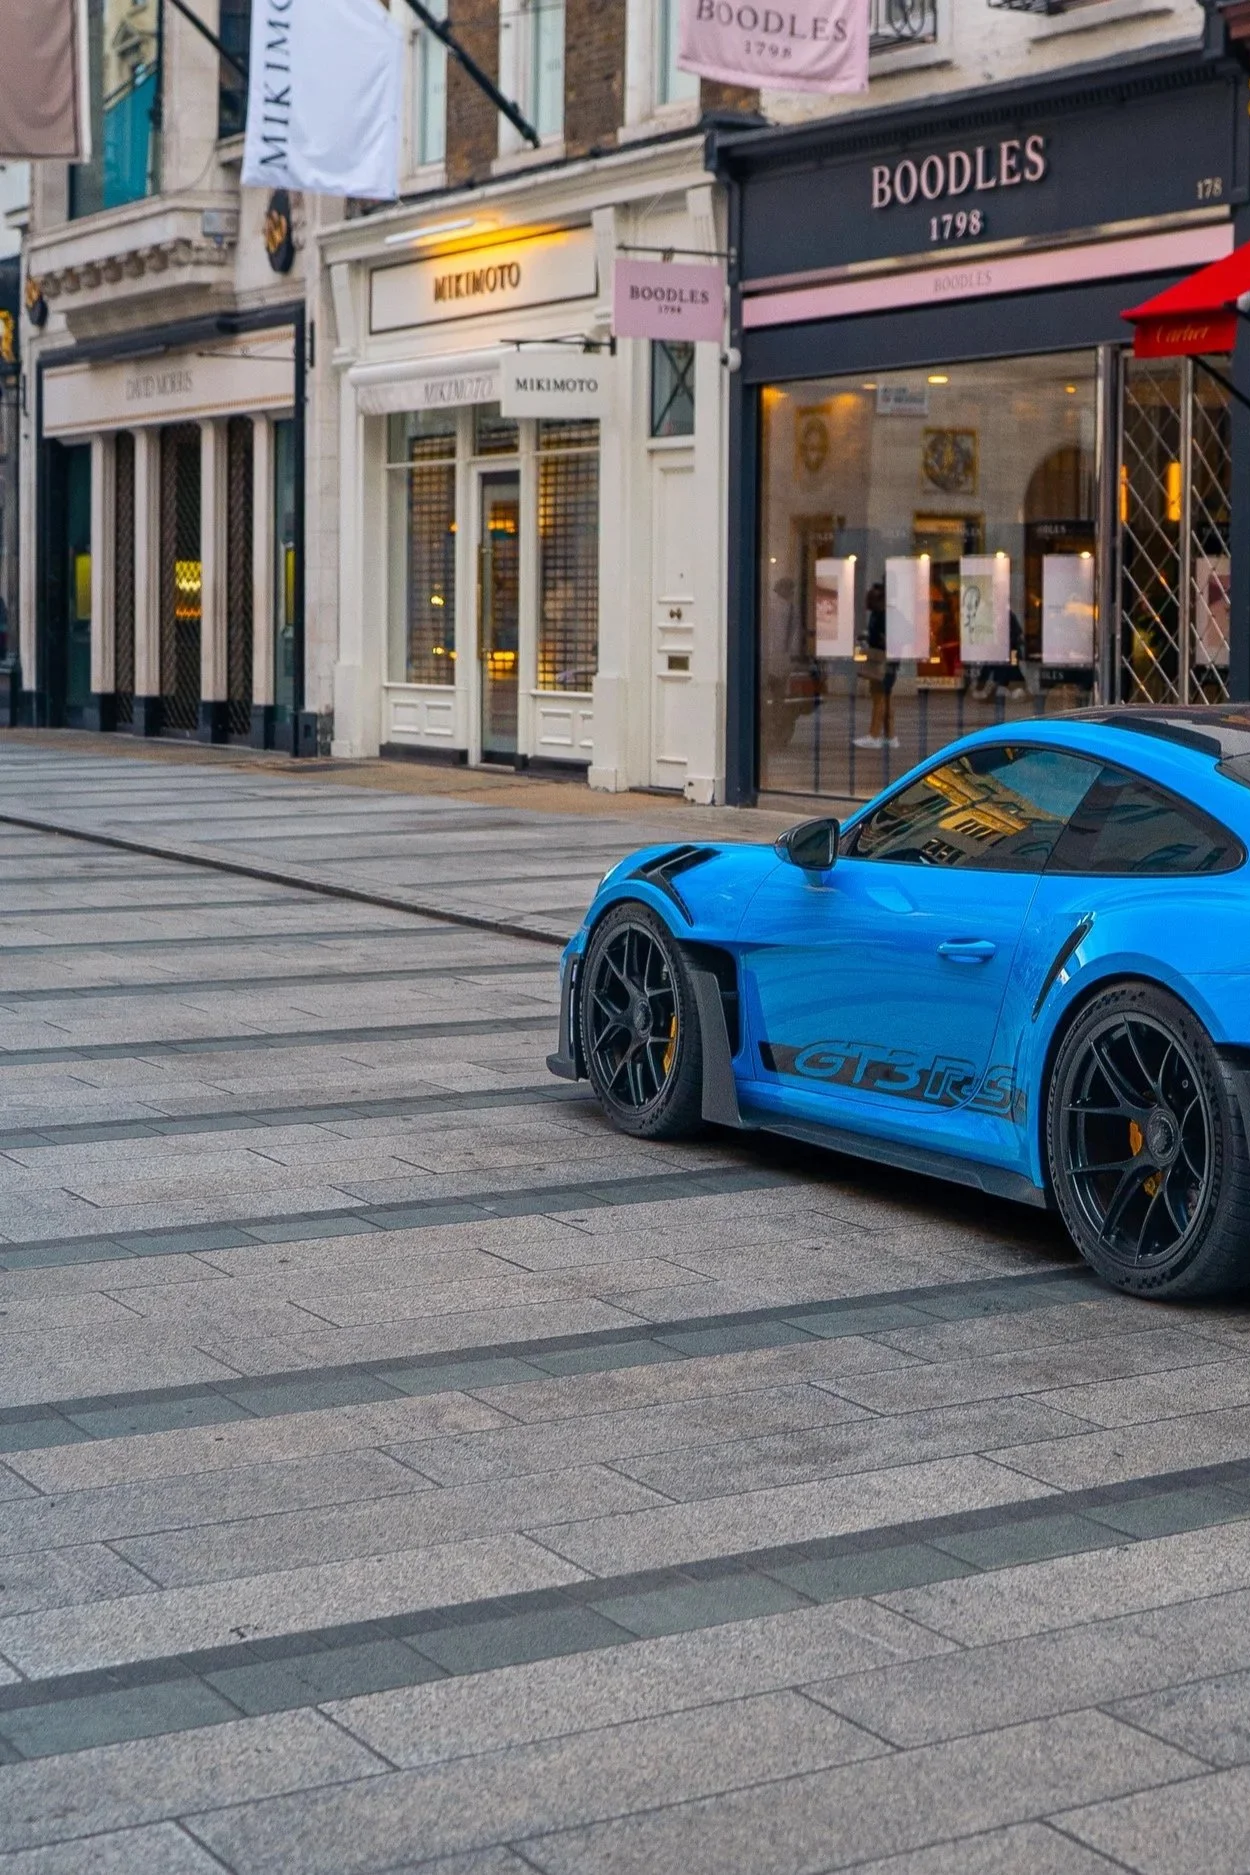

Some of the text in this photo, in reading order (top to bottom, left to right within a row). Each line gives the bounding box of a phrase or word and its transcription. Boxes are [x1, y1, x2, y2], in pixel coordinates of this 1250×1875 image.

[696, 0, 848, 42] BOODLES
[743, 40, 792, 59] 1798
[871, 135, 1047, 209] BOODLES
[1196, 177, 1223, 200] 178
[929, 209, 984, 242] 1798
[434, 262, 521, 303] MIKIMOTO
[934, 269, 992, 293] BOODLES
[629, 284, 710, 305] BOODLES
[657, 305, 682, 315] 1798
[1156, 323, 1210, 343] Cartier
[424, 375, 493, 403] MIKIMOTO
[515, 378, 599, 394] MIKIMOTO
